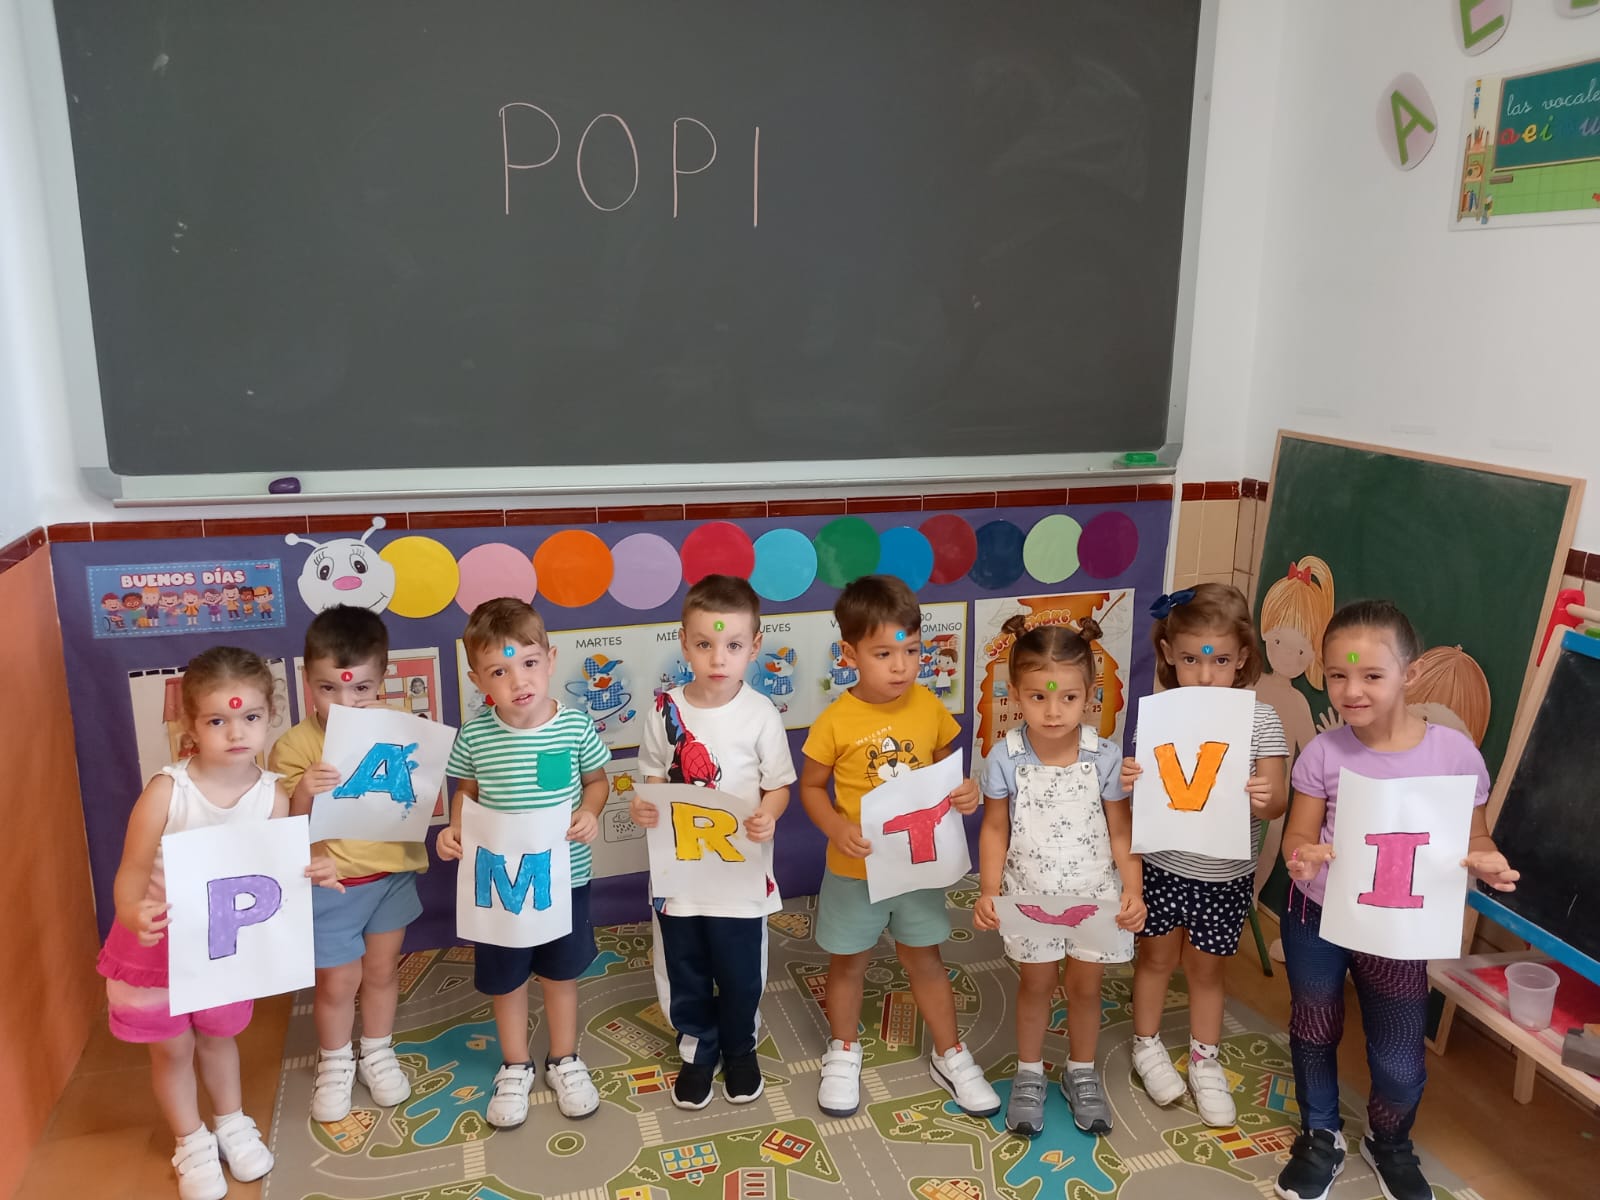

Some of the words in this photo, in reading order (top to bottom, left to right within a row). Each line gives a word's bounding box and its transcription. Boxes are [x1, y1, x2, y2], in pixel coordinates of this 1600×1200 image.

[1390, 90, 1435, 166] A
[1506, 93, 1533, 116] las
[1542, 78, 1600, 110] vocale
[1521, 123, 1537, 143] e
[1540, 114, 1553, 141] i
[498, 102, 760, 227] POPI
[120, 572, 196, 589] BUENOS
[202, 567, 246, 585] DÍAS
[576, 636, 623, 649] MARTES
[759, 623, 791, 634] UEVES
[921, 622, 962, 633] OMINGO
[1013, 712, 1023, 721] 20
[332, 742, 419, 805] A
[1153, 741, 1230, 812] V
[671, 801, 746, 862] R
[882, 795, 952, 864] T
[475, 846, 552, 915] M
[1357, 832, 1431, 909] I
[207, 874, 282, 960] P
